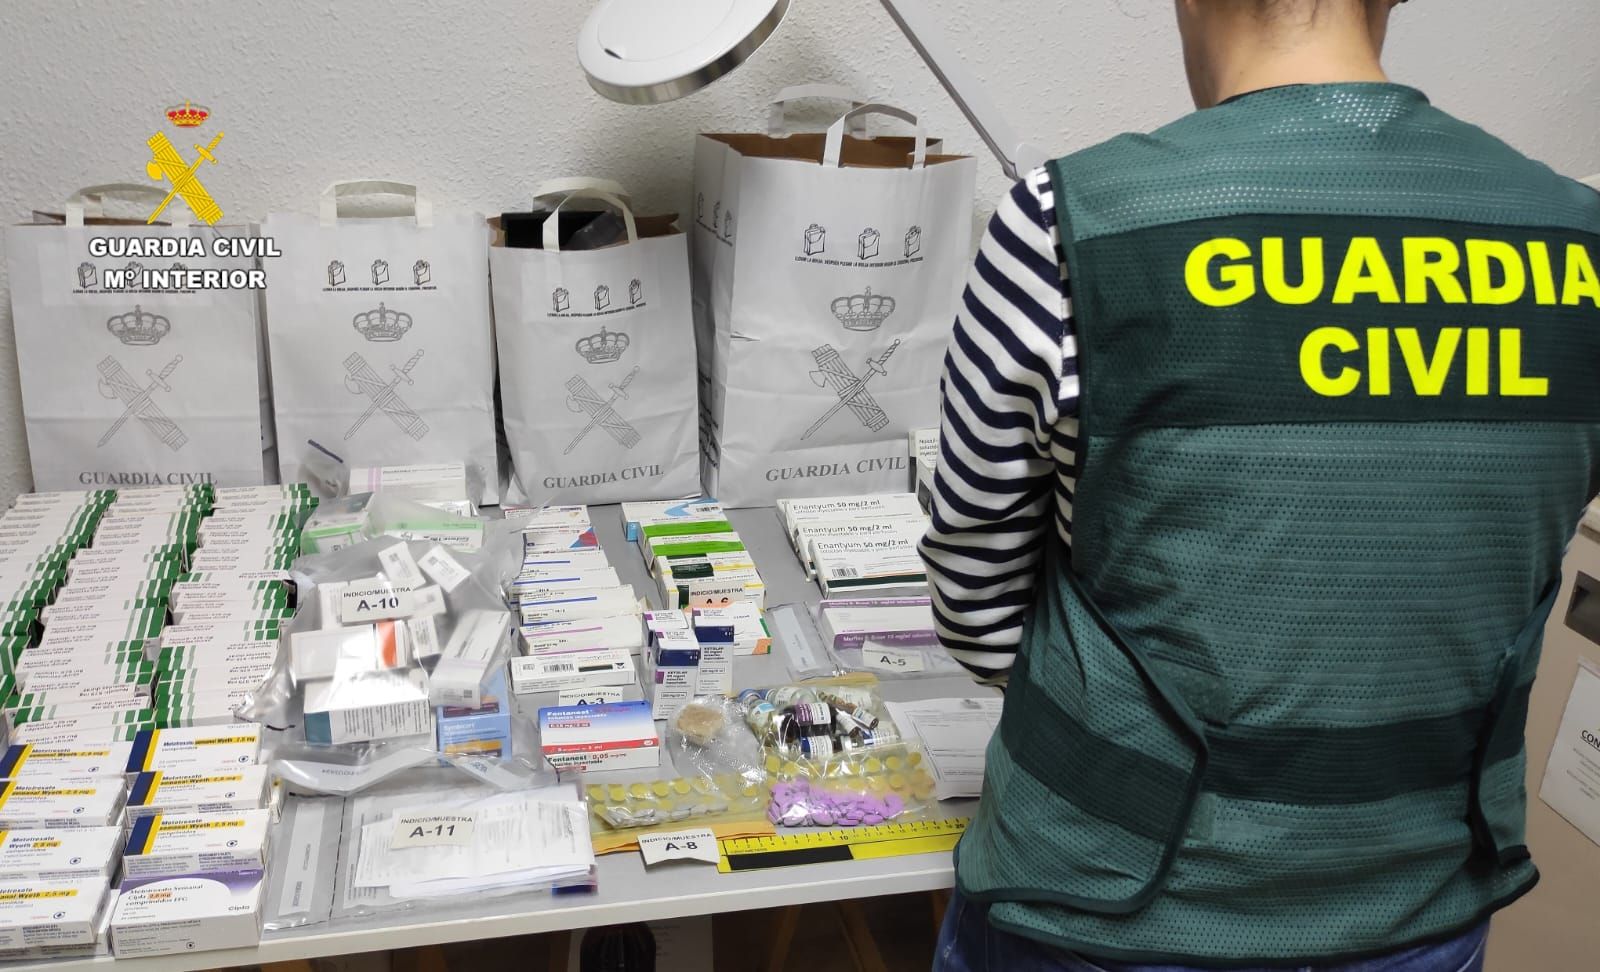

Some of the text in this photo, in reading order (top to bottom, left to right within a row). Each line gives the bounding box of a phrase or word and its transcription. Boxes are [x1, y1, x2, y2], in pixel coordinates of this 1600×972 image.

[1184, 236, 1600, 309] GUARDIA
[1299, 326, 1549, 397] CIVIL
[766, 456, 906, 482] GUARDIA CIVIL
[79, 472, 218, 485] GUARDIA CIVIL
[543, 464, 664, 488] GUARDIA CIVIL
[794, 502, 834, 512] Enantyum
[818, 542, 862, 552] Enantyum
[356, 596, 399, 612] A-10
[880, 656, 906, 666] A-5
[548, 754, 587, 762] Fentanest
[400, 816, 473, 824] INDICIO/MUESTRA
[409, 824, 456, 838] A-11
[665, 842, 698, 851] A-8
